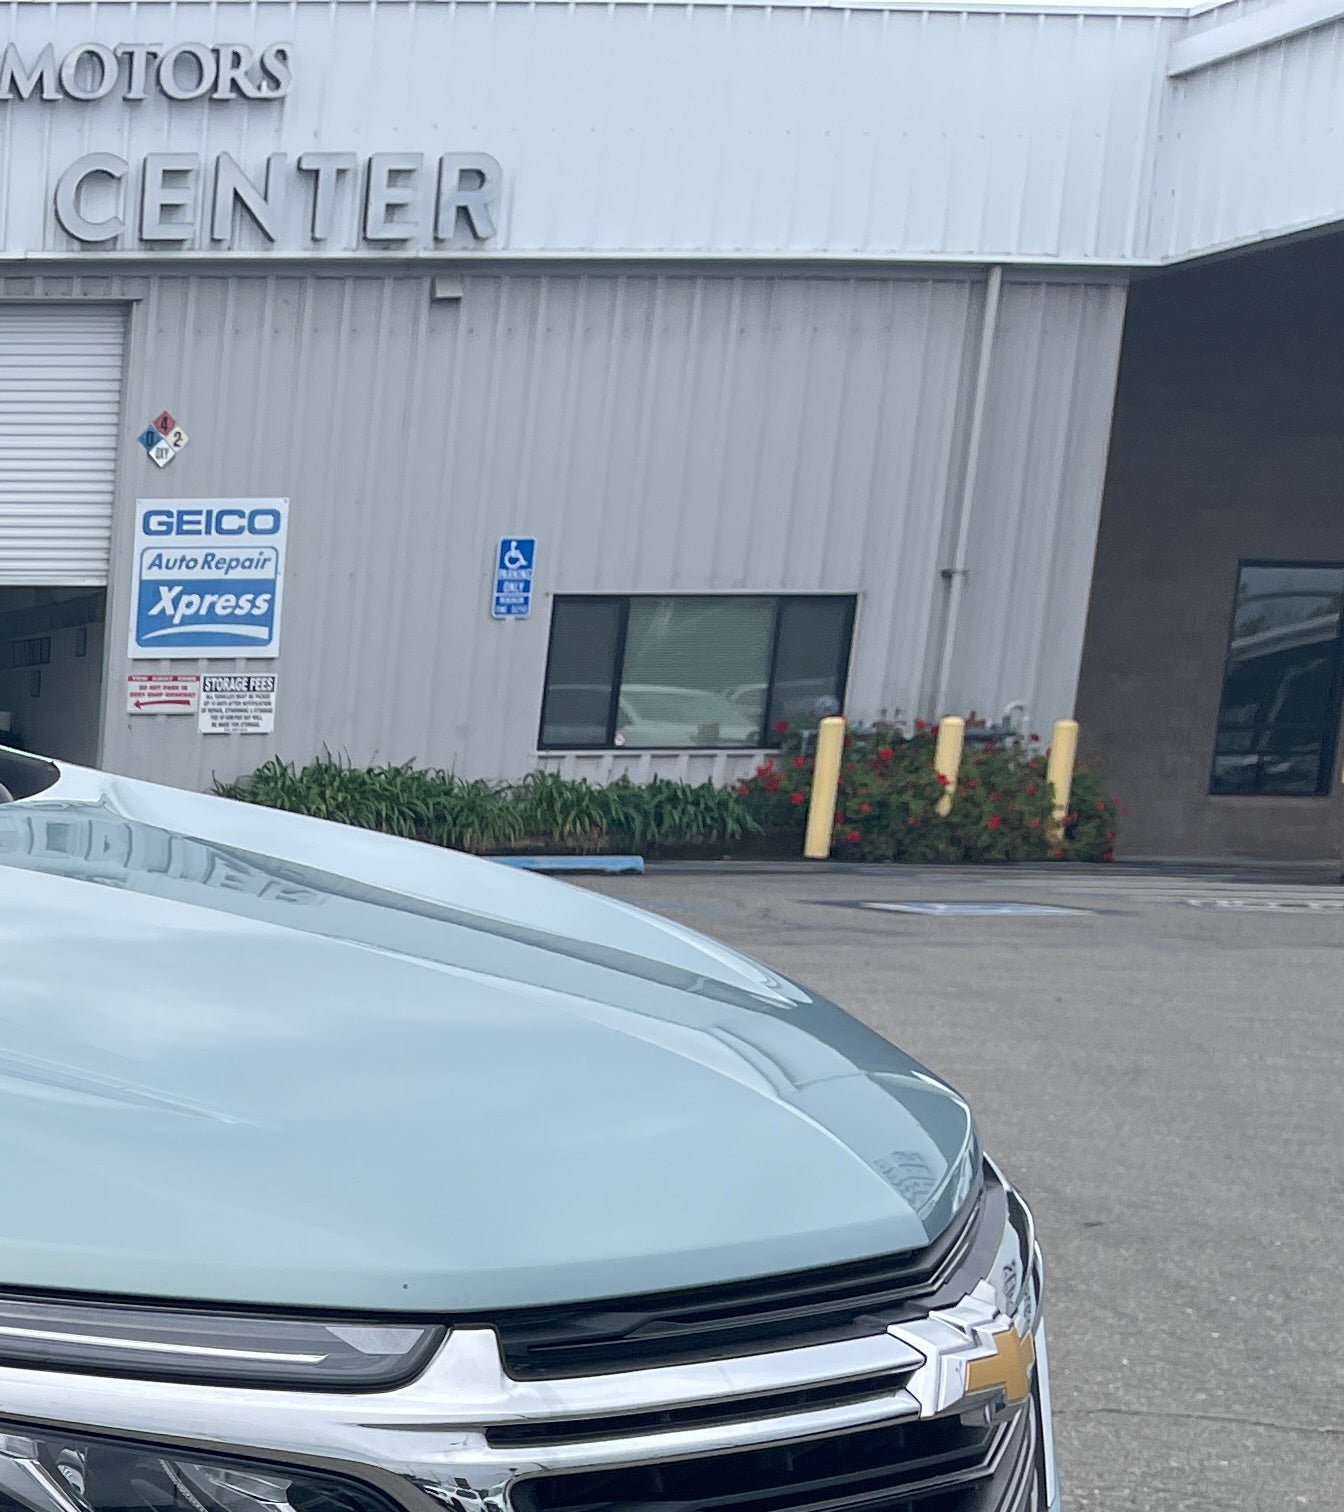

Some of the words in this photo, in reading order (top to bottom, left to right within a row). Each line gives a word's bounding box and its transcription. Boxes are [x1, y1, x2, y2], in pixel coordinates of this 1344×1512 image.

[53, 149, 505, 245] CENTER
[160, 415, 169, 431] 4
[173, 431, 183, 447] 2
[142, 508, 282, 536] GEICO
[147, 552, 199, 571] Auto
[199, 551, 272, 576] Repair
[148, 585, 273, 625] Xpress
[204, 677, 249, 692] STORAGE
[249, 677, 274, 692] FEES
